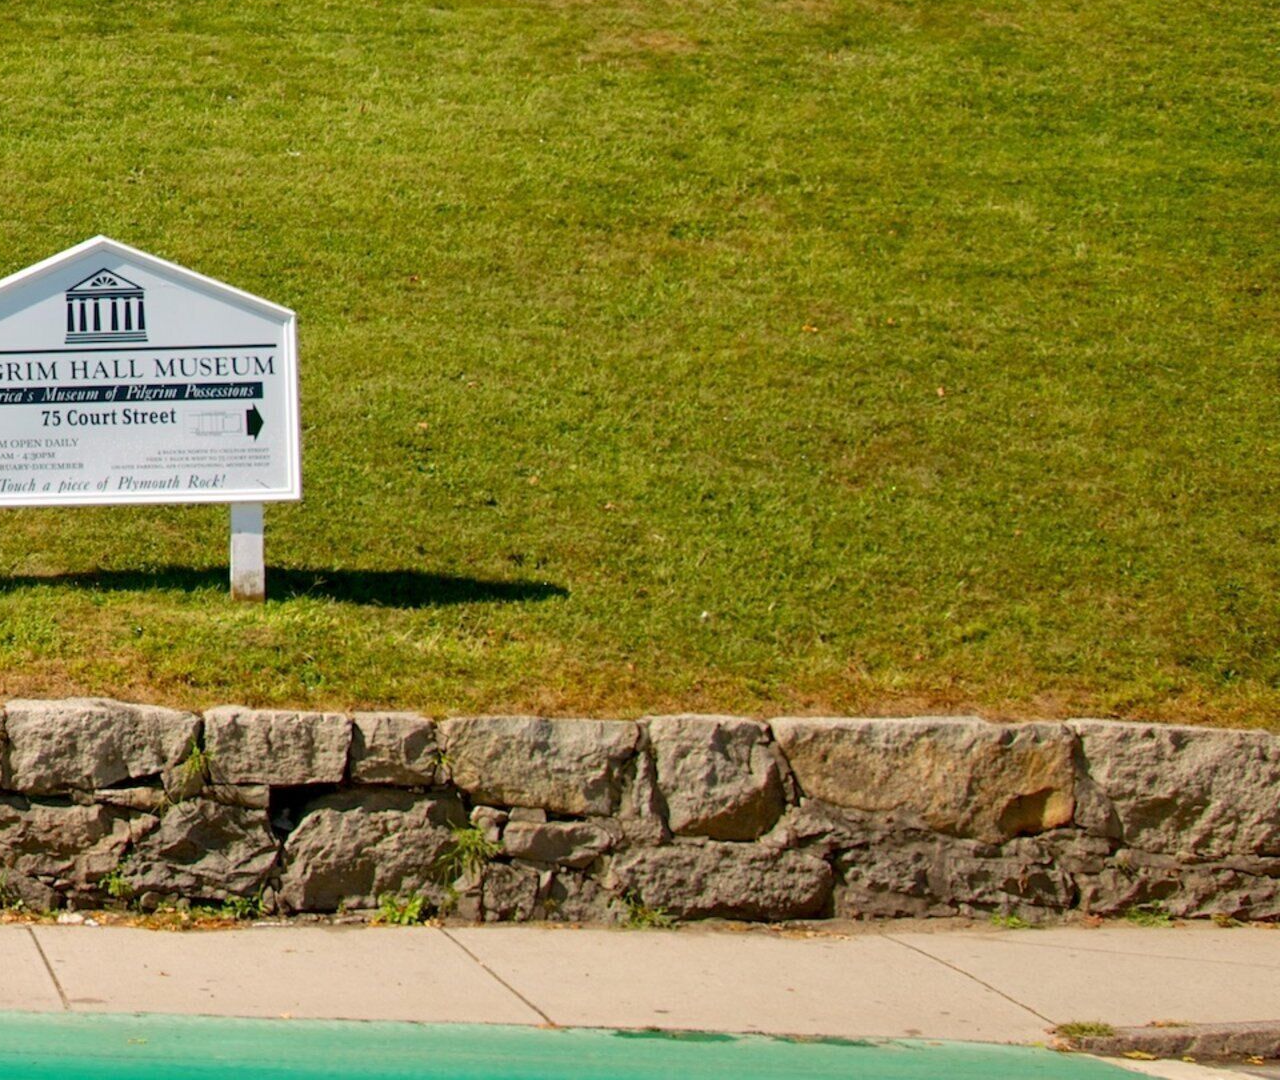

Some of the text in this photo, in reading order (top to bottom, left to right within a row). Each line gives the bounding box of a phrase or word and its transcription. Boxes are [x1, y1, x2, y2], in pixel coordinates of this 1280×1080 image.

[70, 358, 143, 380] HALL
[154, 356, 275, 378] MUSEUM
[41, 386, 99, 402] Museum
[104, 385, 119, 402] of
[126, 383, 178, 401] Pilgrim
[184, 382, 255, 399] Possessions
[42, 407, 177, 427] 75 Court Street
[10, 439, 42, 449] OPEN
[45, 437, 79, 447] DAILY
[0, 473, 227, 494] Touch a piece of Plymouth Rock!
